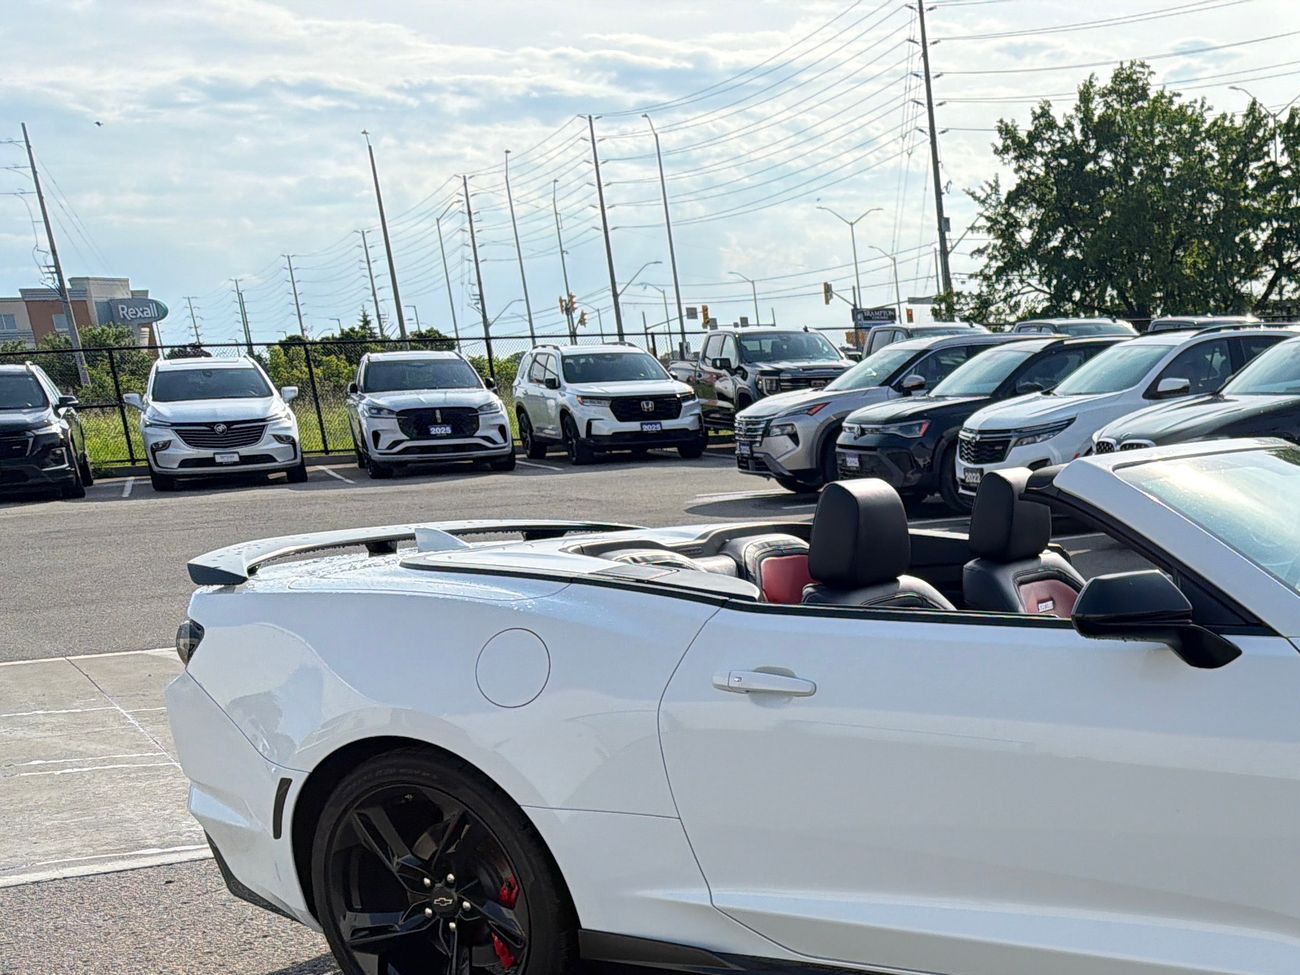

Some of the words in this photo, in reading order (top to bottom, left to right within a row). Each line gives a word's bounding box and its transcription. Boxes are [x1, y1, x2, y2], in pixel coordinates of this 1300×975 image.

[118, 302, 158, 320] Rexall
[430, 426, 452, 435] 2025
[965, 472, 981, 483] 2022
